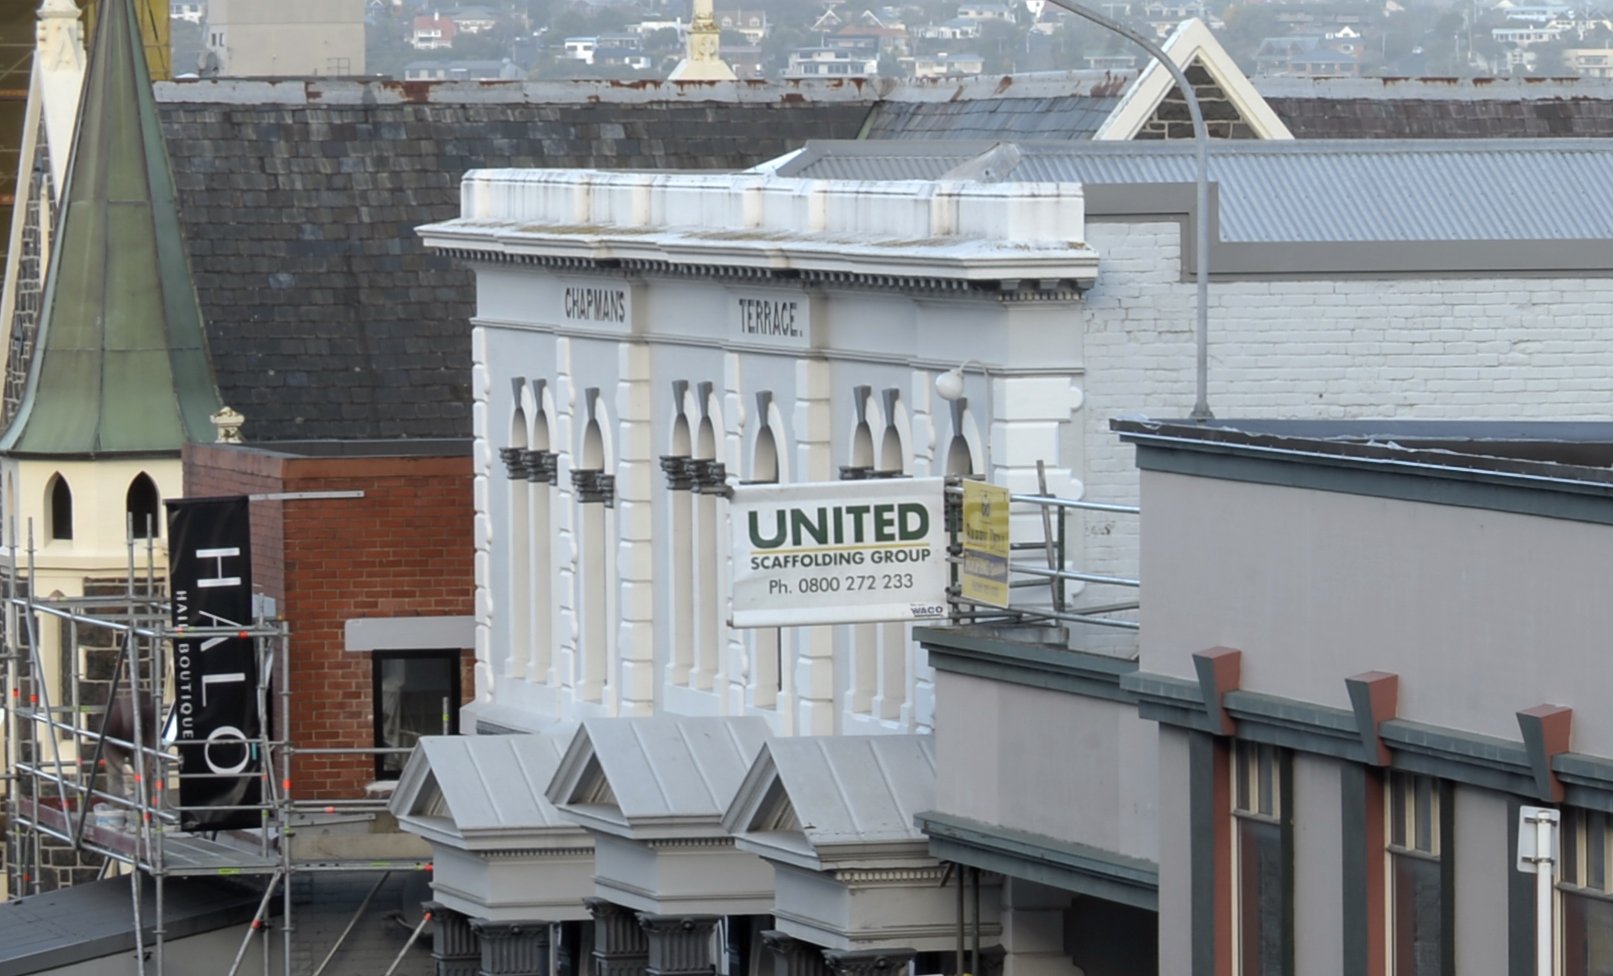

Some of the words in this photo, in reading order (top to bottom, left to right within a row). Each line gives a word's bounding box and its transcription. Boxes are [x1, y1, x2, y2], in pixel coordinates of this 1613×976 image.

[748, 502, 930, 549] UNITED
[751, 551, 865, 570] SCAFFOLDING
[870, 549, 931, 565] GROUP
[769, 579, 792, 595] Ph.
[798, 576, 840, 593] 0800
[846, 574, 876, 591] 272
[883, 573, 914, 590] 233
[178, 642, 194, 739] BOUTIQUE
